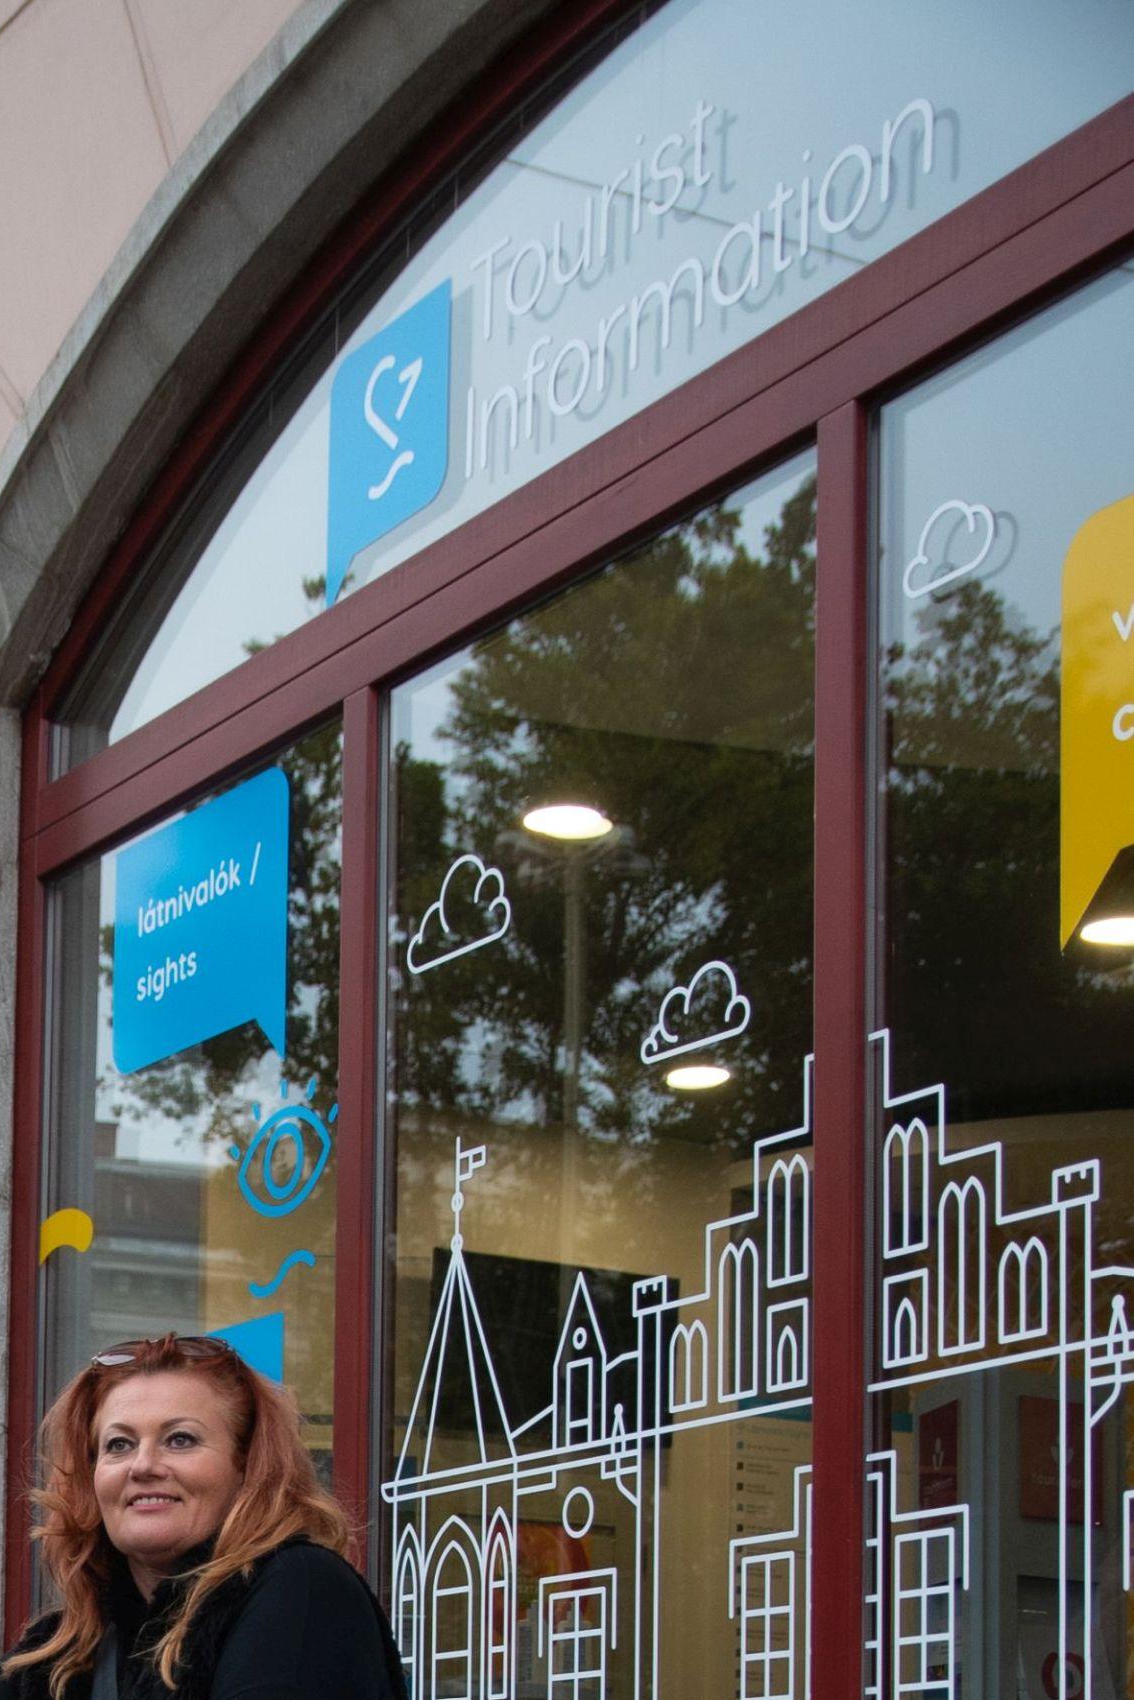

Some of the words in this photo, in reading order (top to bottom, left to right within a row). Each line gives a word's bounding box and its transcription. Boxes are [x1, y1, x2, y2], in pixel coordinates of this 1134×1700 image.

[465, 97, 935, 479] Information
[470, 99, 714, 340] Tourist
[137, 858, 241, 938] látnivalók
[249, 840, 262, 887] /
[136, 951, 198, 1002] sights
